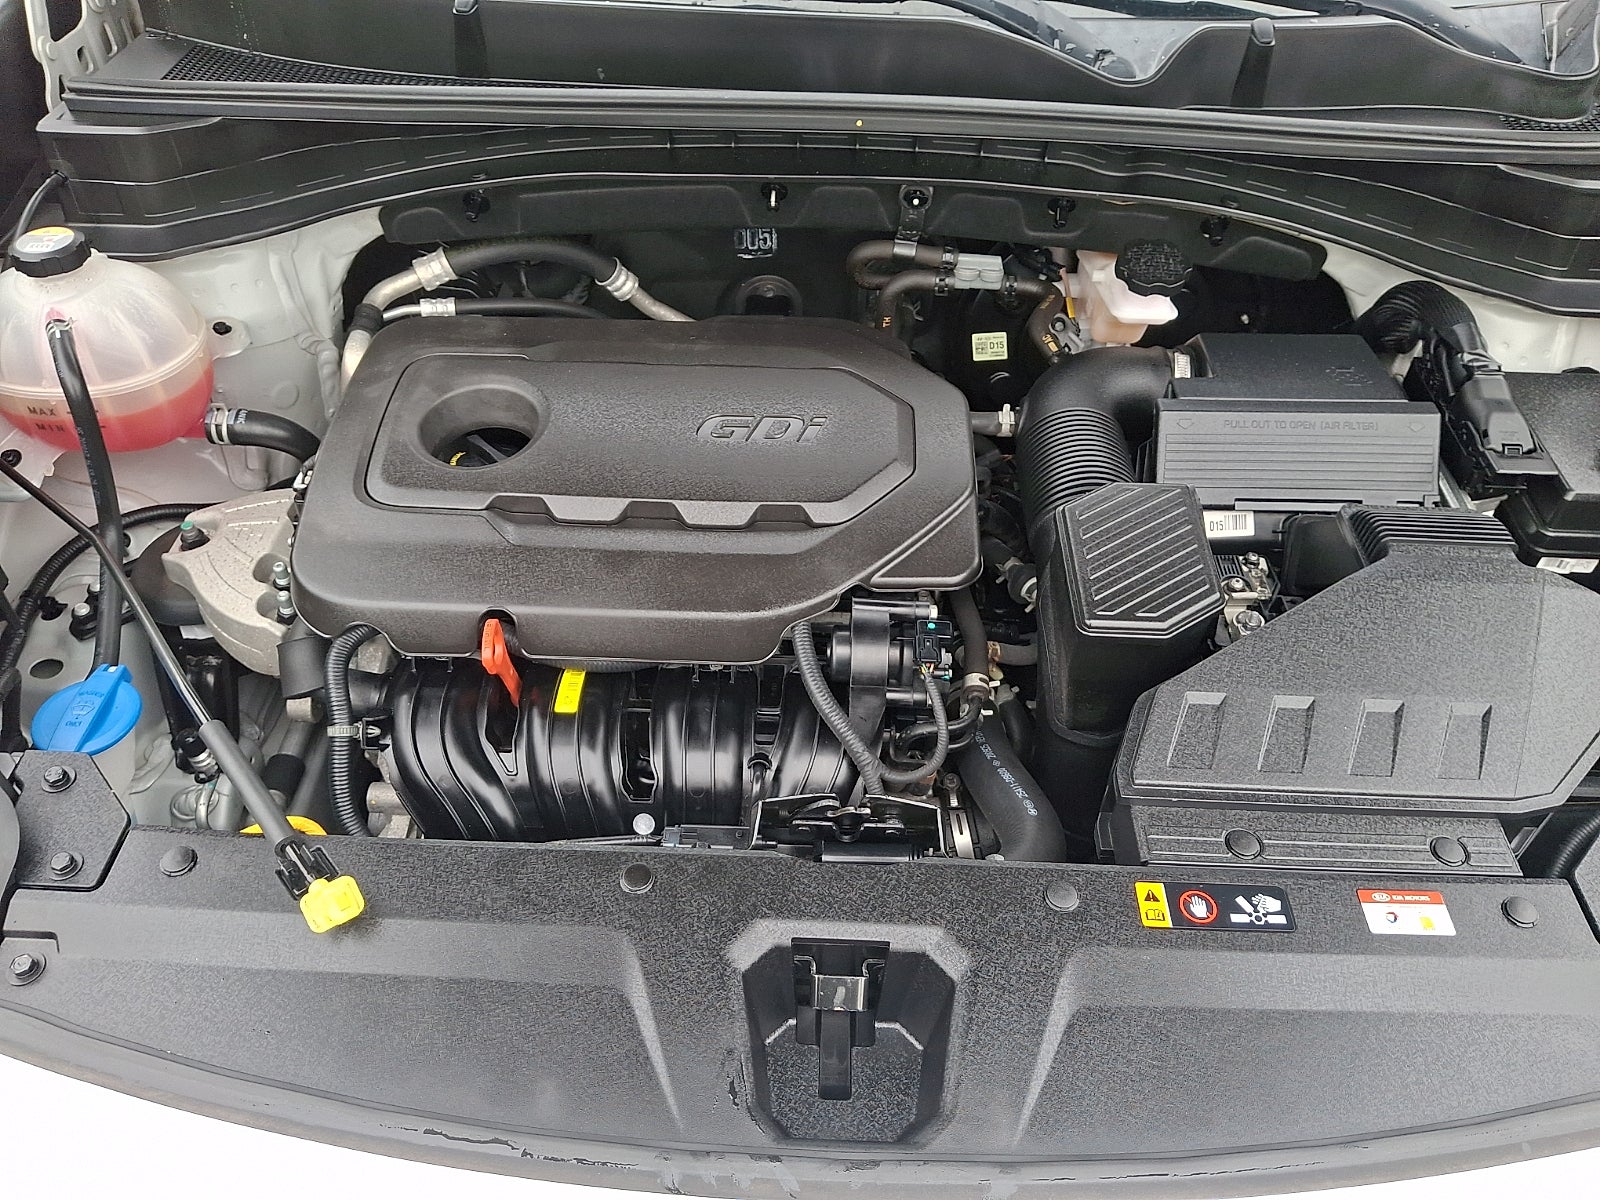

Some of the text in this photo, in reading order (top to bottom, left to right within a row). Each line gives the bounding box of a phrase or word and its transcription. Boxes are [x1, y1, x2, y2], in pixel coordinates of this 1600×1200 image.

[989, 341, 1005, 350] D15
[27, 406, 57, 416] MAX
[35, 422, 65, 432] MIN
[696, 414, 828, 442] GDi
[1223, 419, 1249, 429] PULL
[1251, 420, 1272, 429] OUT
[1273, 420, 1287, 430] TO
[1289, 420, 1316, 430] OPEN
